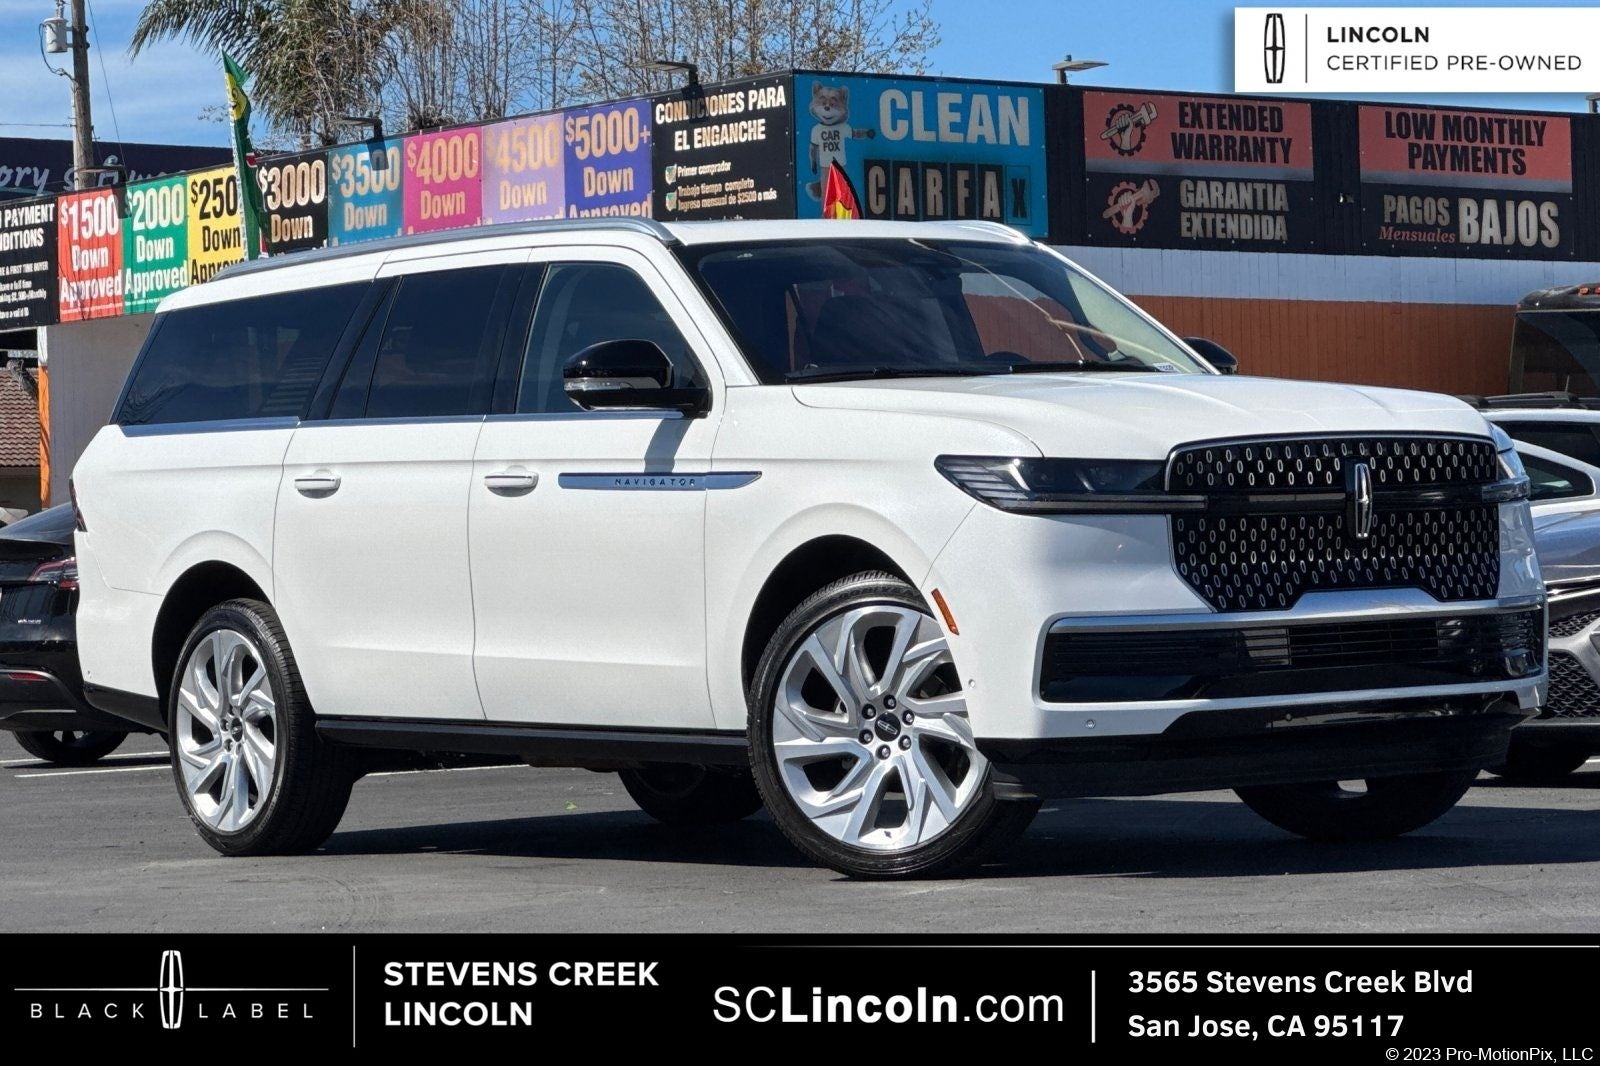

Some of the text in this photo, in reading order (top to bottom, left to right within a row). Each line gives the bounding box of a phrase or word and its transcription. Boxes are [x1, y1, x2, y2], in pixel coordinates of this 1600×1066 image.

[655, 85, 786, 125] CONDICIONES PARA
[879, 88, 1030, 146] CLEAN
[1178, 101, 1283, 133] EXTENDED
[565, 107, 650, 161] $5000+
[674, 118, 766, 151] EL ENGANCHE
[821, 130, 840, 141] CAR
[1384, 111, 1547, 147] LOW MONTHLY
[407, 132, 479, 185] $4000
[485, 121, 560, 175] $4500
[823, 141, 840, 151] FOX
[1171, 131, 1293, 164] WARRANTY
[1407, 142, 1527, 175] PAYMENTS
[259, 159, 326, 211] $3000
[331, 146, 400, 197] $3500
[583, 165, 634, 198] Down
[677, 160, 731, 177] Primer comprador
[124, 183, 185, 231] $2000
[191, 175, 238, 221] $250
[420, 190, 466, 219] Down
[500, 179, 547, 210] Down
[868, 165, 1027, 219] CARFAX
[1179, 179, 1290, 212] GARANTIA
[4, 203, 55, 228] PAYMENT
[60, 195, 119, 241] $1500
[270, 213, 313, 243] Down
[344, 202, 388, 231] Down
[1180, 211, 1289, 242] EXTENDIDA
[1383, 194, 1560, 248] PAGOS BAJOS
[136, 235, 174, 262] Down
[202, 225, 241, 252] Down
[1378, 225, 1456, 243] Mensuales
[71, 244, 109, 271] Down
[190, 258, 245, 285] Appr
[60, 269, 122, 312] Approved
[124, 260, 188, 300] Approved
[614, 478, 696, 487] NAVIGATOR
